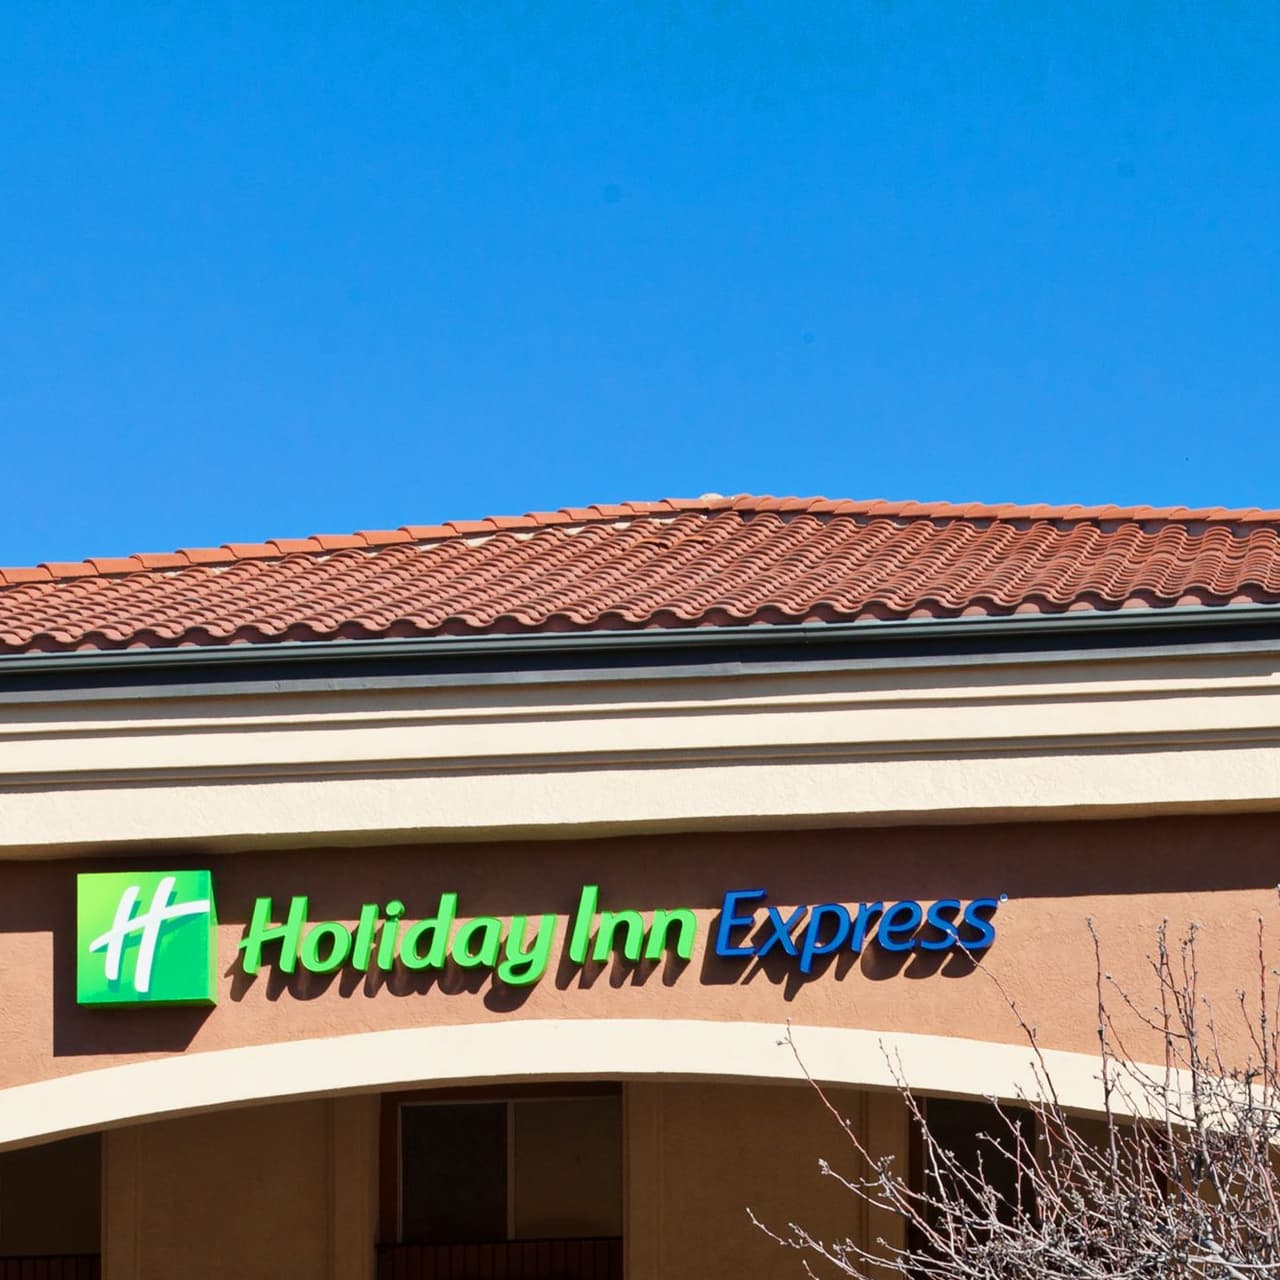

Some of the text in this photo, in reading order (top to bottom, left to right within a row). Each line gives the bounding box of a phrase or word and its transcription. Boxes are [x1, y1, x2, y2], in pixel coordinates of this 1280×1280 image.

[237, 883, 998, 987] Holiday Inn Express
